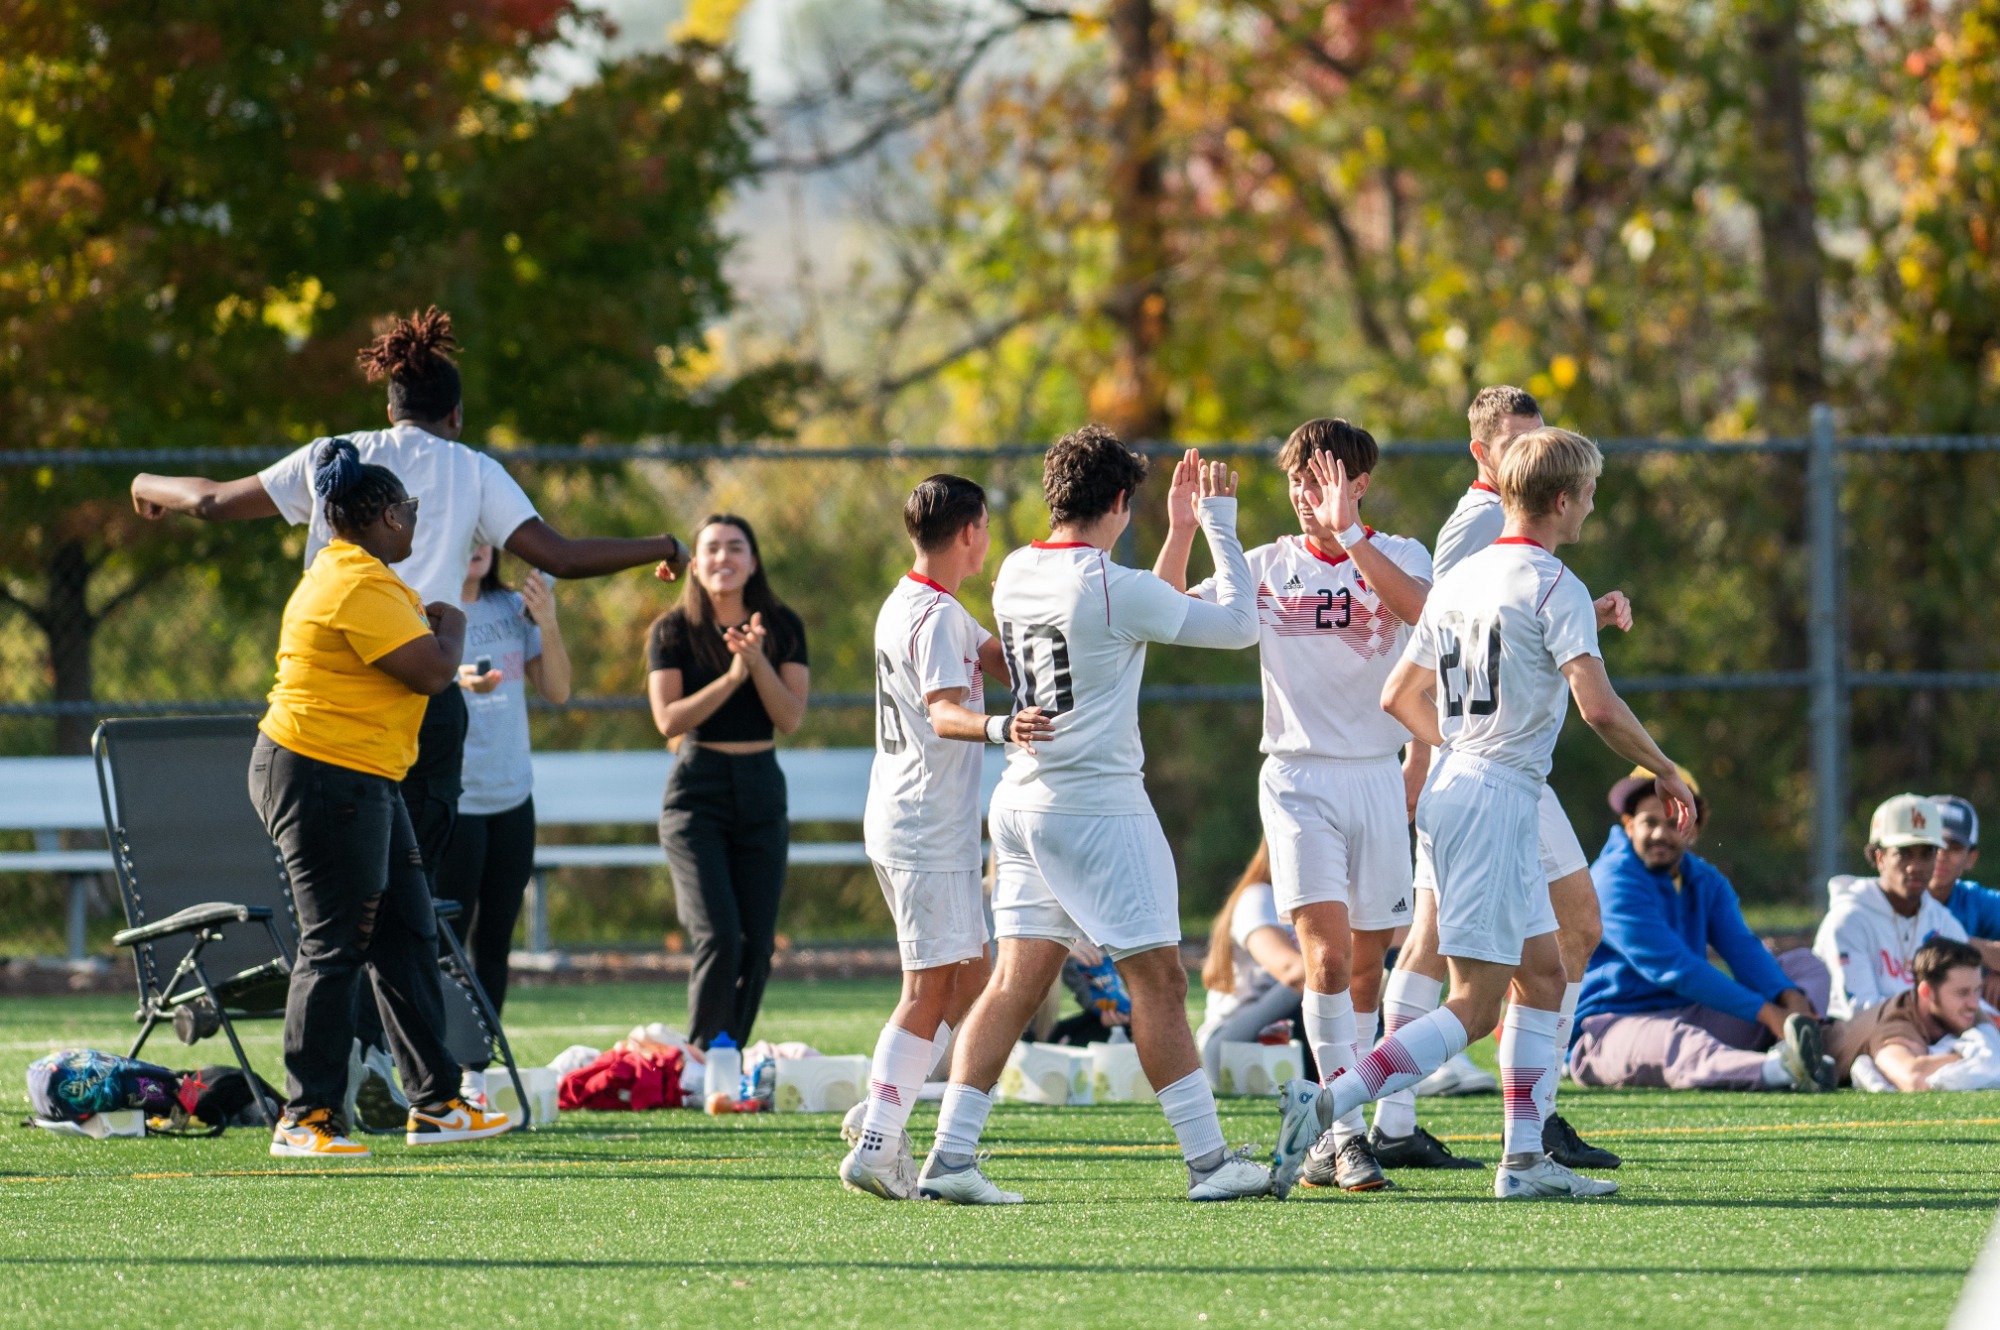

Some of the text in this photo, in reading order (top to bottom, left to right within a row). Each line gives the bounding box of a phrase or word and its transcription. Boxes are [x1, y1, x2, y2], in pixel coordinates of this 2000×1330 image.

[1316, 587, 1350, 628] 23
[1002, 621, 1075, 721] 10
[1438, 610, 1501, 717] 20
[1911, 806, 1926, 829] LA
